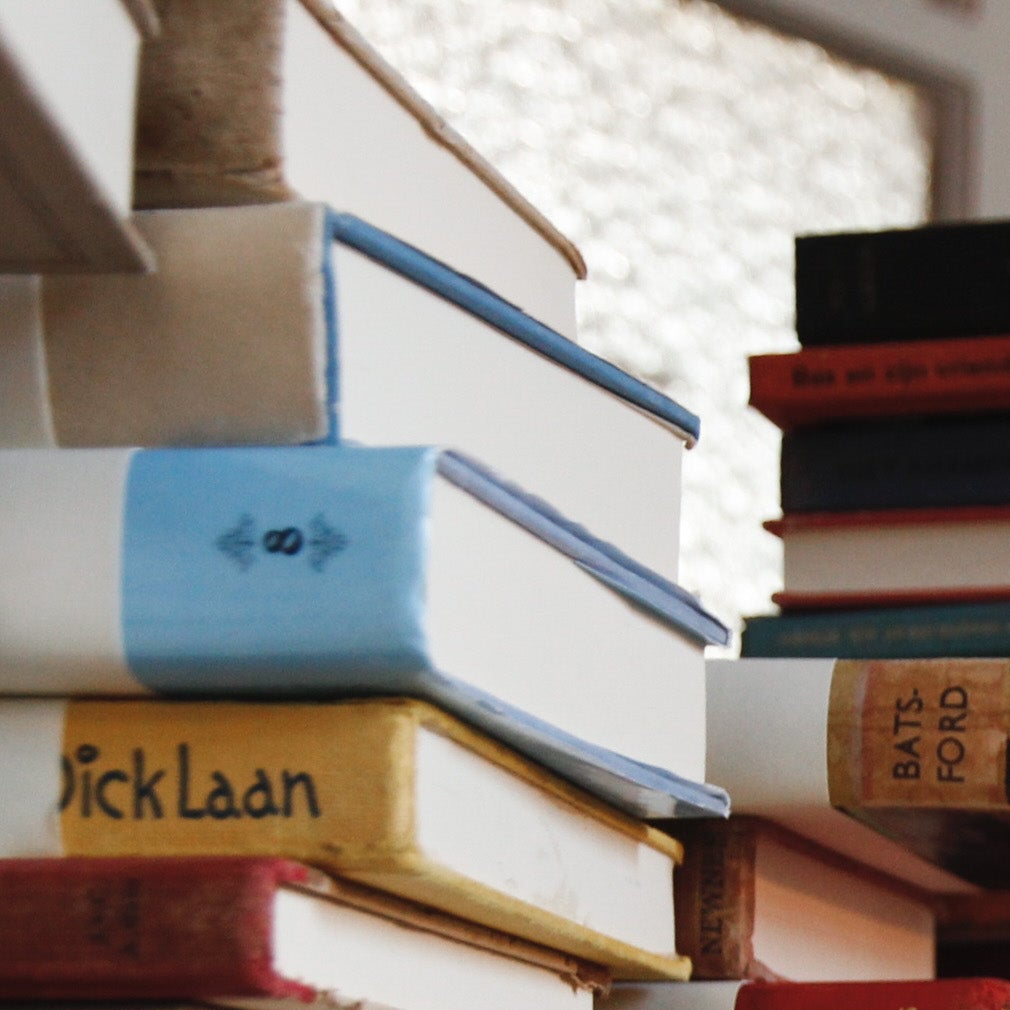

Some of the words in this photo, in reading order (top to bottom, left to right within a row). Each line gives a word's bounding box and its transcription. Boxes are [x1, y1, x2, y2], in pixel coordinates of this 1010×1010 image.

[892, 687, 924, 780] BATS-
[936, 685, 969, 784] FORD
[176, 743, 321, 819] Laan
